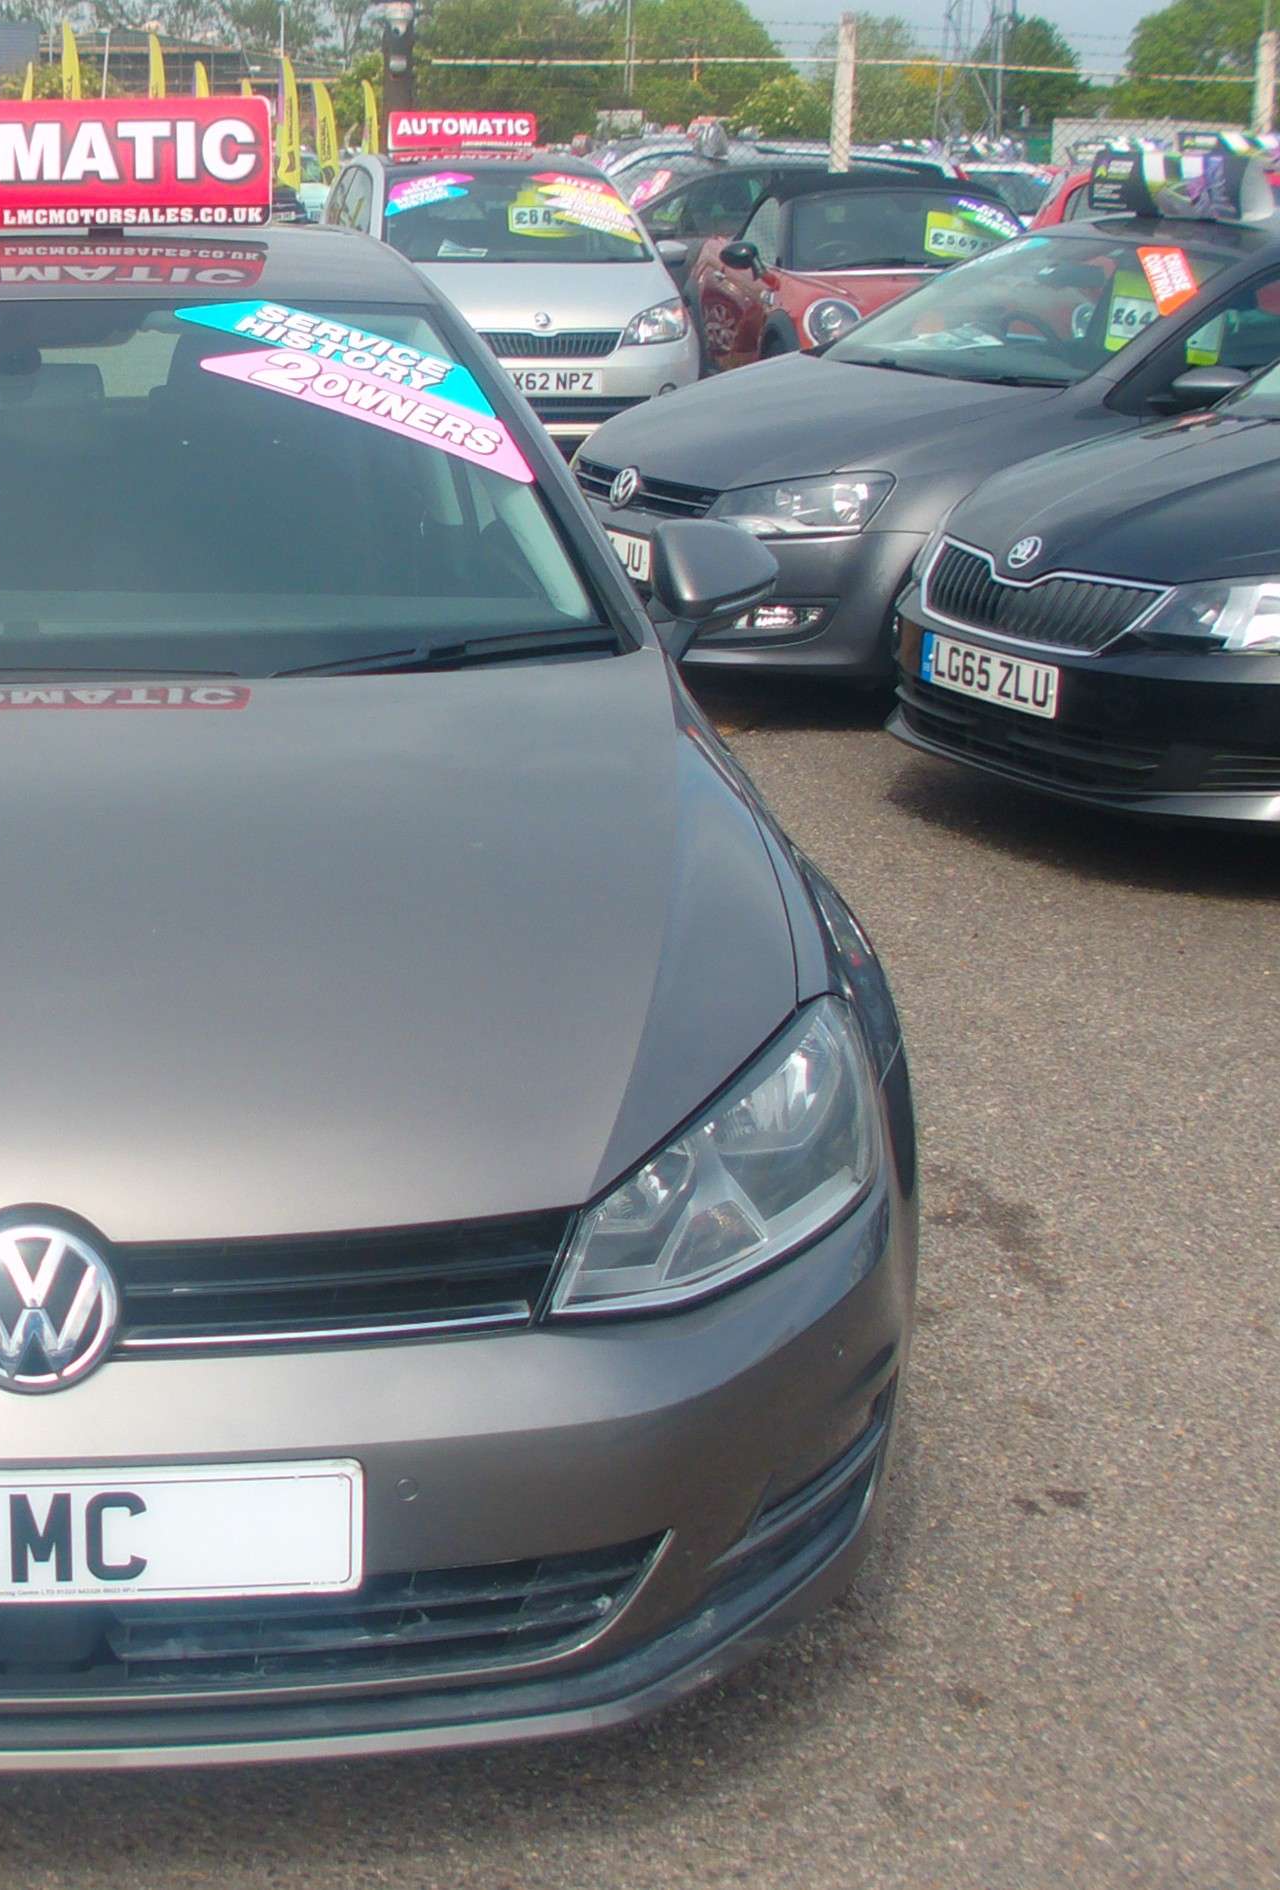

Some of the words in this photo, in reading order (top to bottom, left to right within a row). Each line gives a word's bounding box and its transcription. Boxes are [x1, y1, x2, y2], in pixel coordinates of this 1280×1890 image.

[396, 118, 531, 136] AUTOMATIC
[3, 206, 263, 227] LMCMOTORSALES.CO.UK
[513, 210, 566, 226] £64
[234, 317, 447, 392] HISTORY
[254, 304, 456, 381] SERVICE
[248, 352, 324, 395] 2
[309, 374, 502, 455] OWNERS
[555, 372, 594, 392] NPZ
[934, 641, 991, 692] LG65
[997, 660, 1050, 708] ZLU
